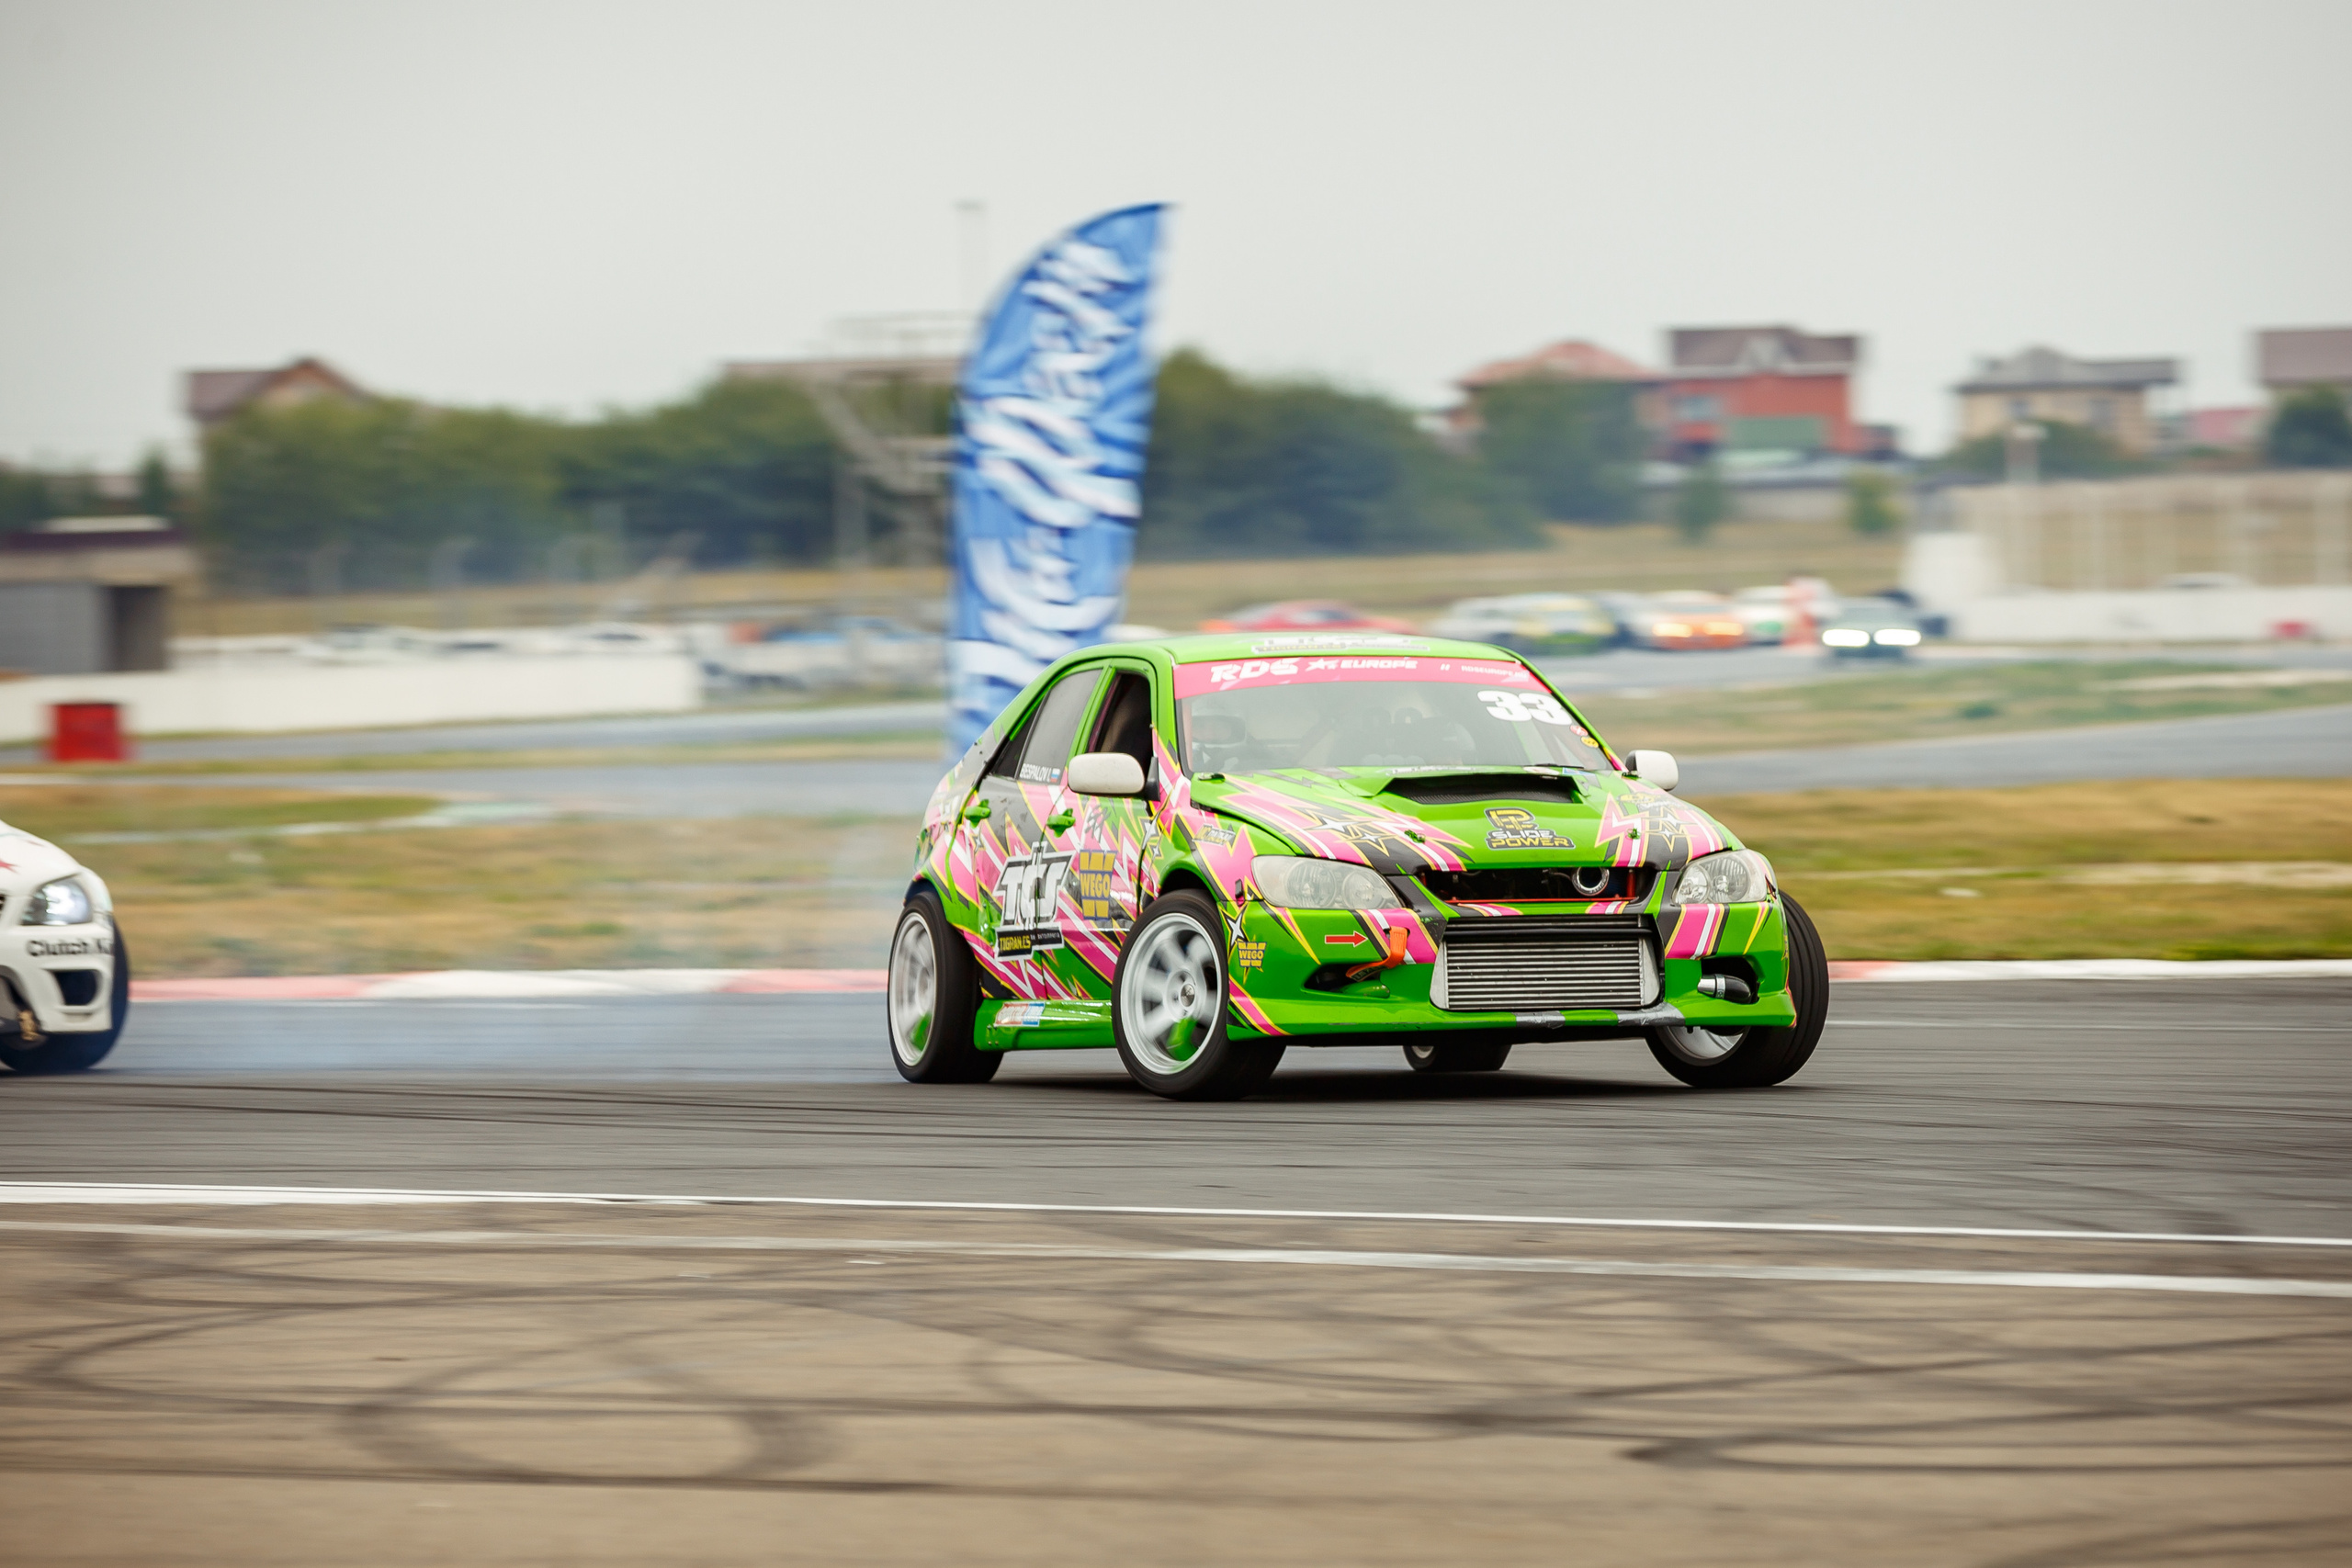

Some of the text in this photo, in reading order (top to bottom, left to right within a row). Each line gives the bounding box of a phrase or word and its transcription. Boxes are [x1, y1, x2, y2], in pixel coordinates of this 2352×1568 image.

[1340, 659, 1419, 670] EUROPE
[1476, 690, 1572, 726] 33
[1491, 829, 1554, 840] SLIDE
[1490, 837, 1570, 848] POWER
[1080, 873, 1111, 898] WEGO
[27, 938, 88, 956] Clutch
[1238, 950, 1264, 960] WEGO
